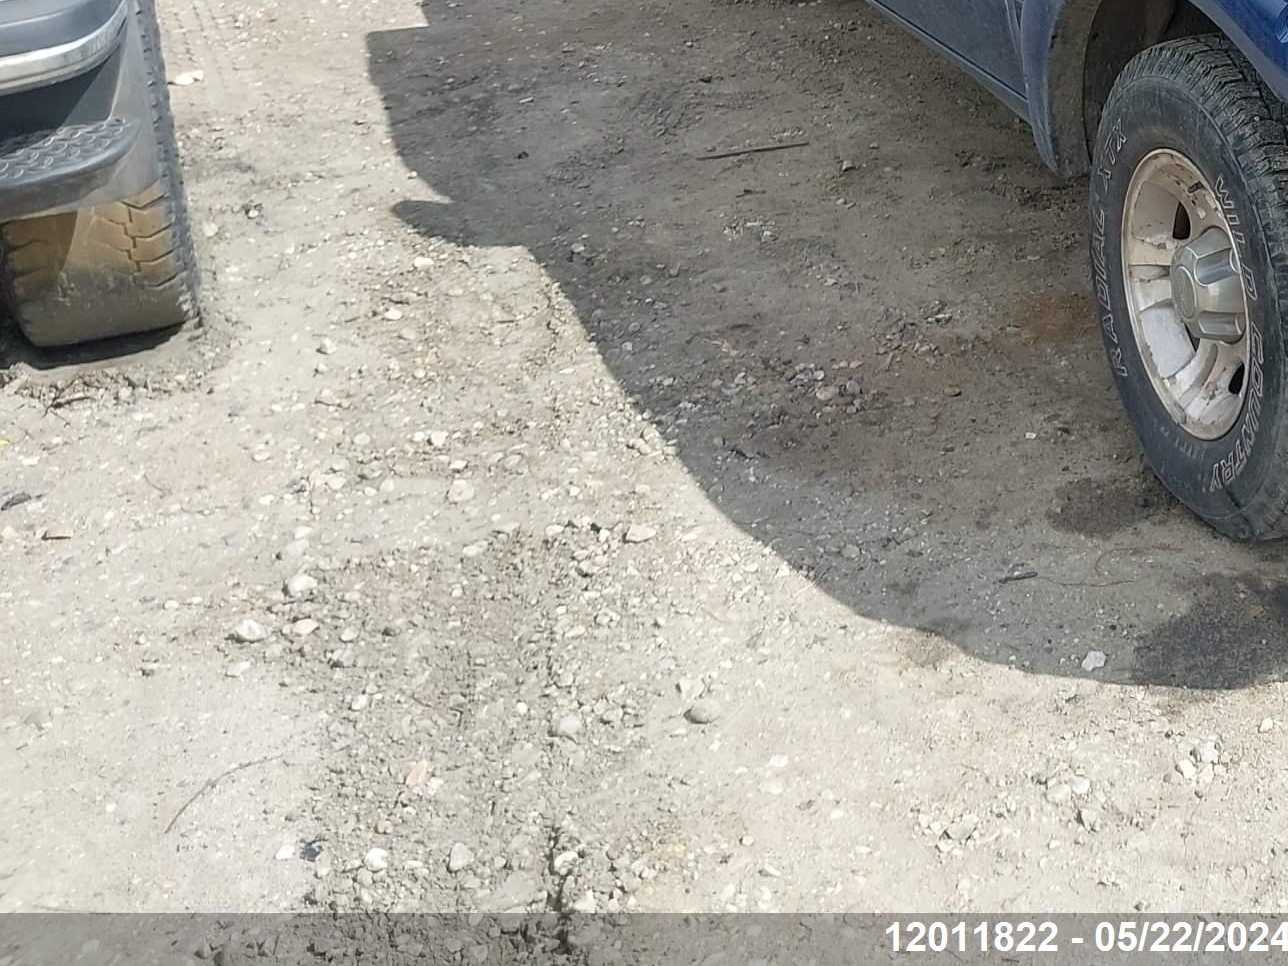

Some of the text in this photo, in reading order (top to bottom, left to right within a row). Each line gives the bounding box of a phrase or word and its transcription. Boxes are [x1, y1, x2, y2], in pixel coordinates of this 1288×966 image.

[1093, 208, 1130, 378] RADIAL
[1208, 177, 1265, 493] WILD COUNTRY
